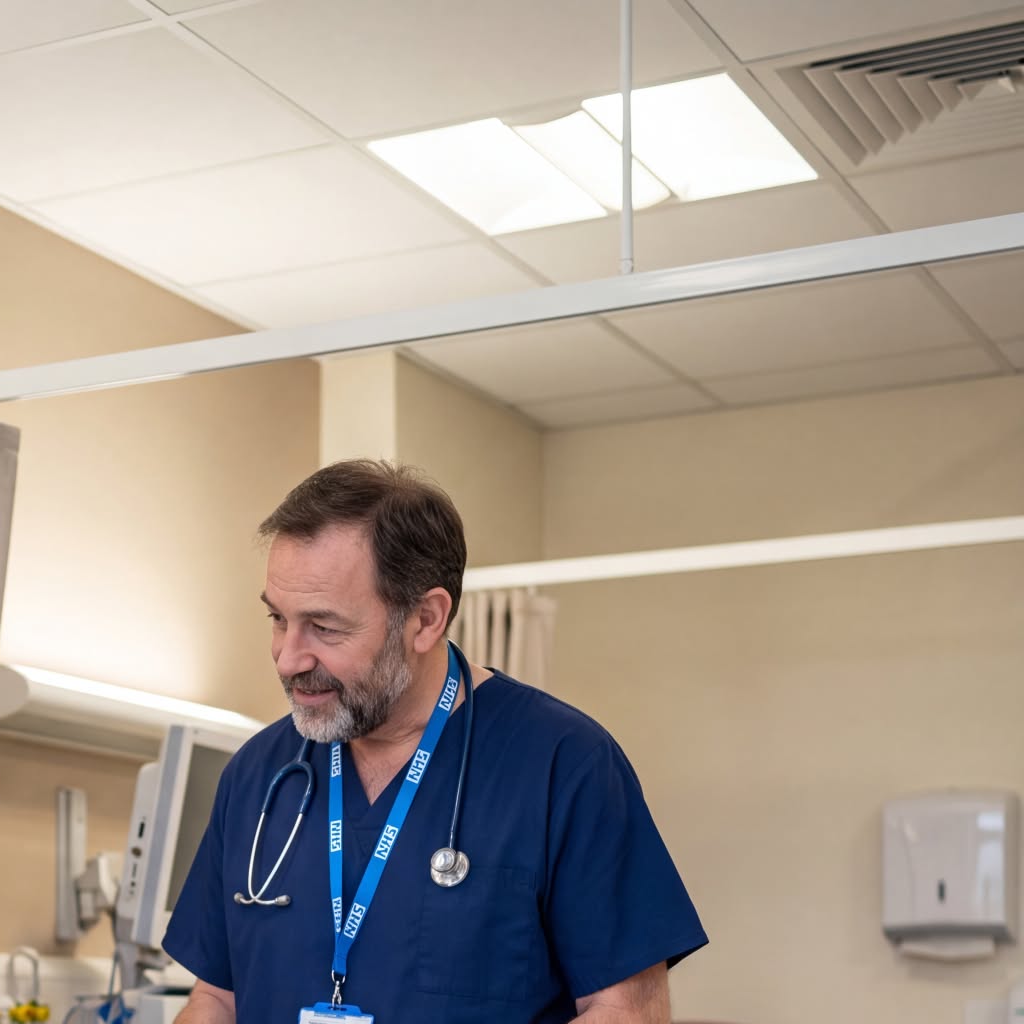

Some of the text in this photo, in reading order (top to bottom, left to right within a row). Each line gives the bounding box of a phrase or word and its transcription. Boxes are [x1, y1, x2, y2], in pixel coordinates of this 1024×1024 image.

[407, 750, 429, 783] NHS
[375, 826, 397, 859] NHS
[344, 904, 365, 937] NHS
